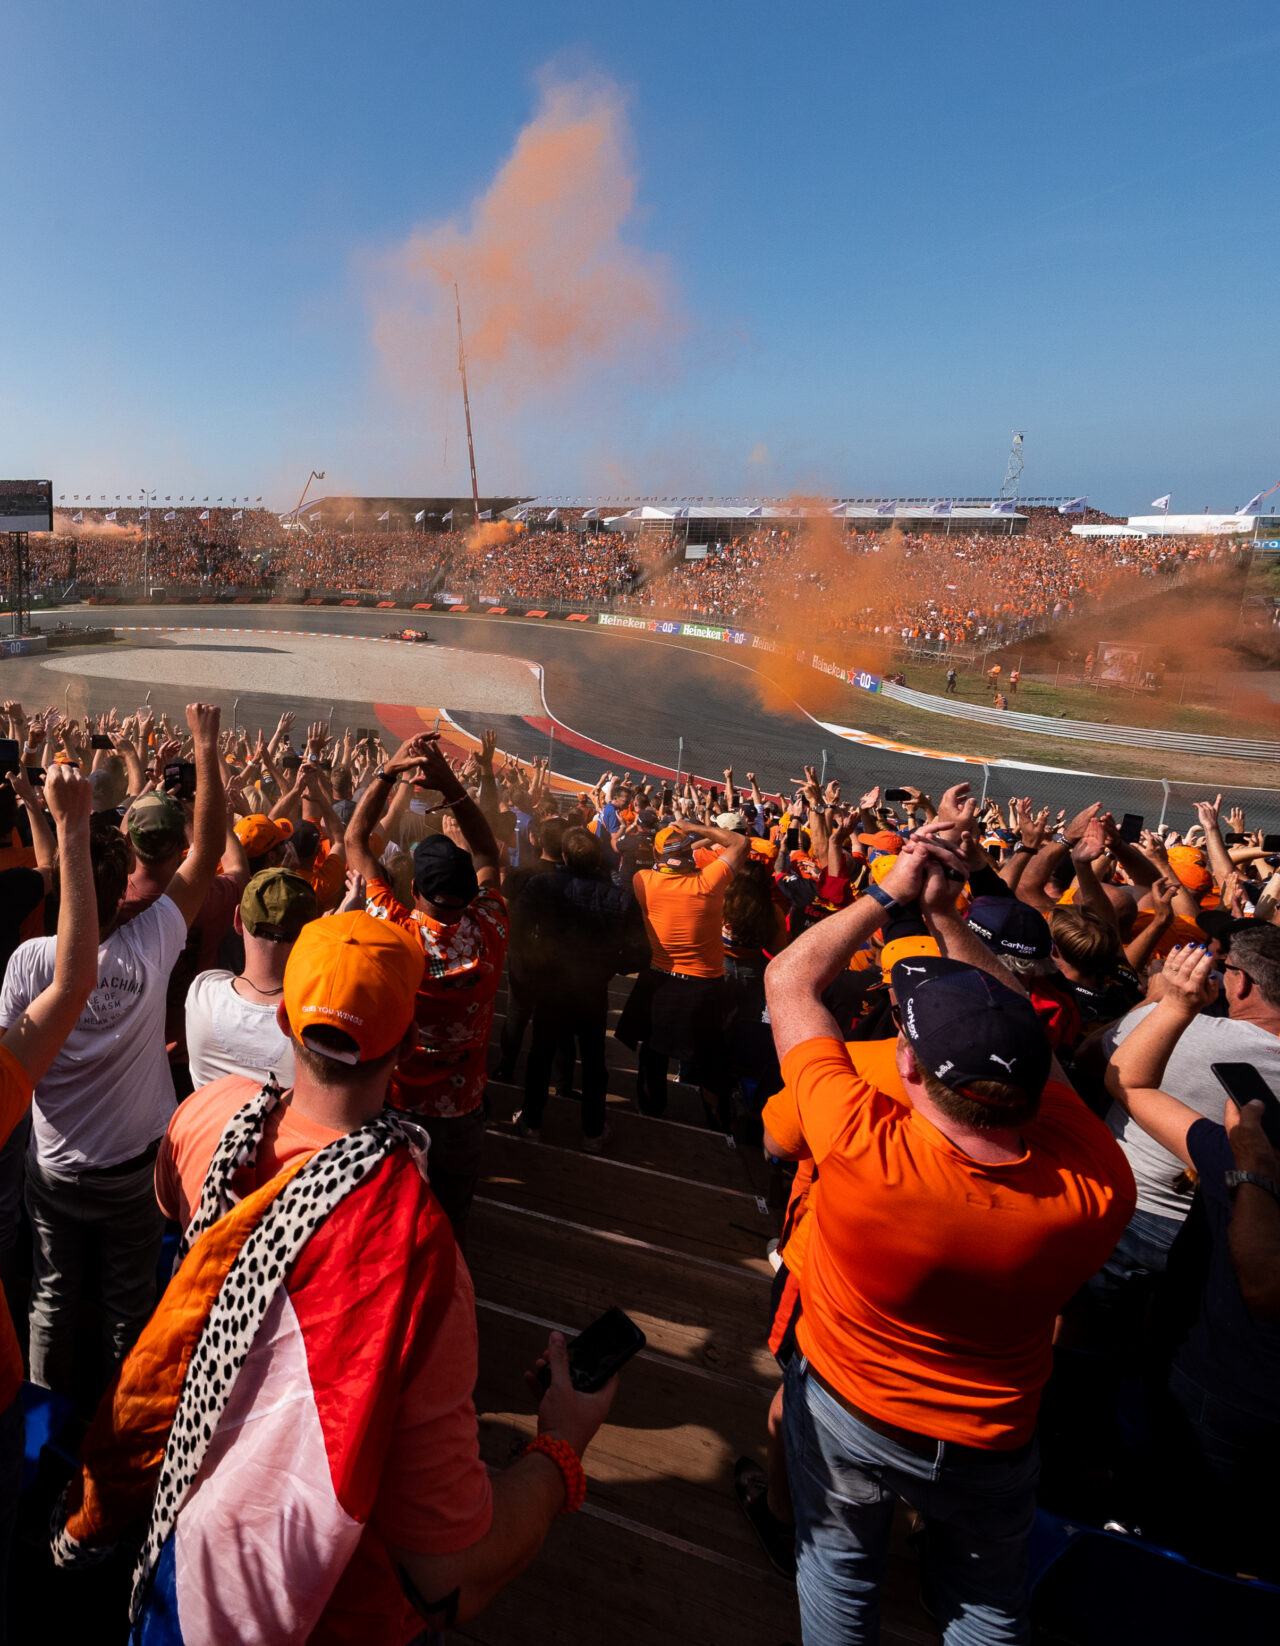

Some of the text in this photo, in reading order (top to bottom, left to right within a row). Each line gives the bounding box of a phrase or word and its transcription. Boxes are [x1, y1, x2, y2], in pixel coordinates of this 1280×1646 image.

[600, 615, 646, 629] Heineken
[682, 624, 721, 640] Heineken
[811, 655, 846, 680] Heineken
[1000, 940, 1036, 951] CarNext
[318, 1006, 334, 1015] YOU
[337, 1010, 364, 1026] WINGS
